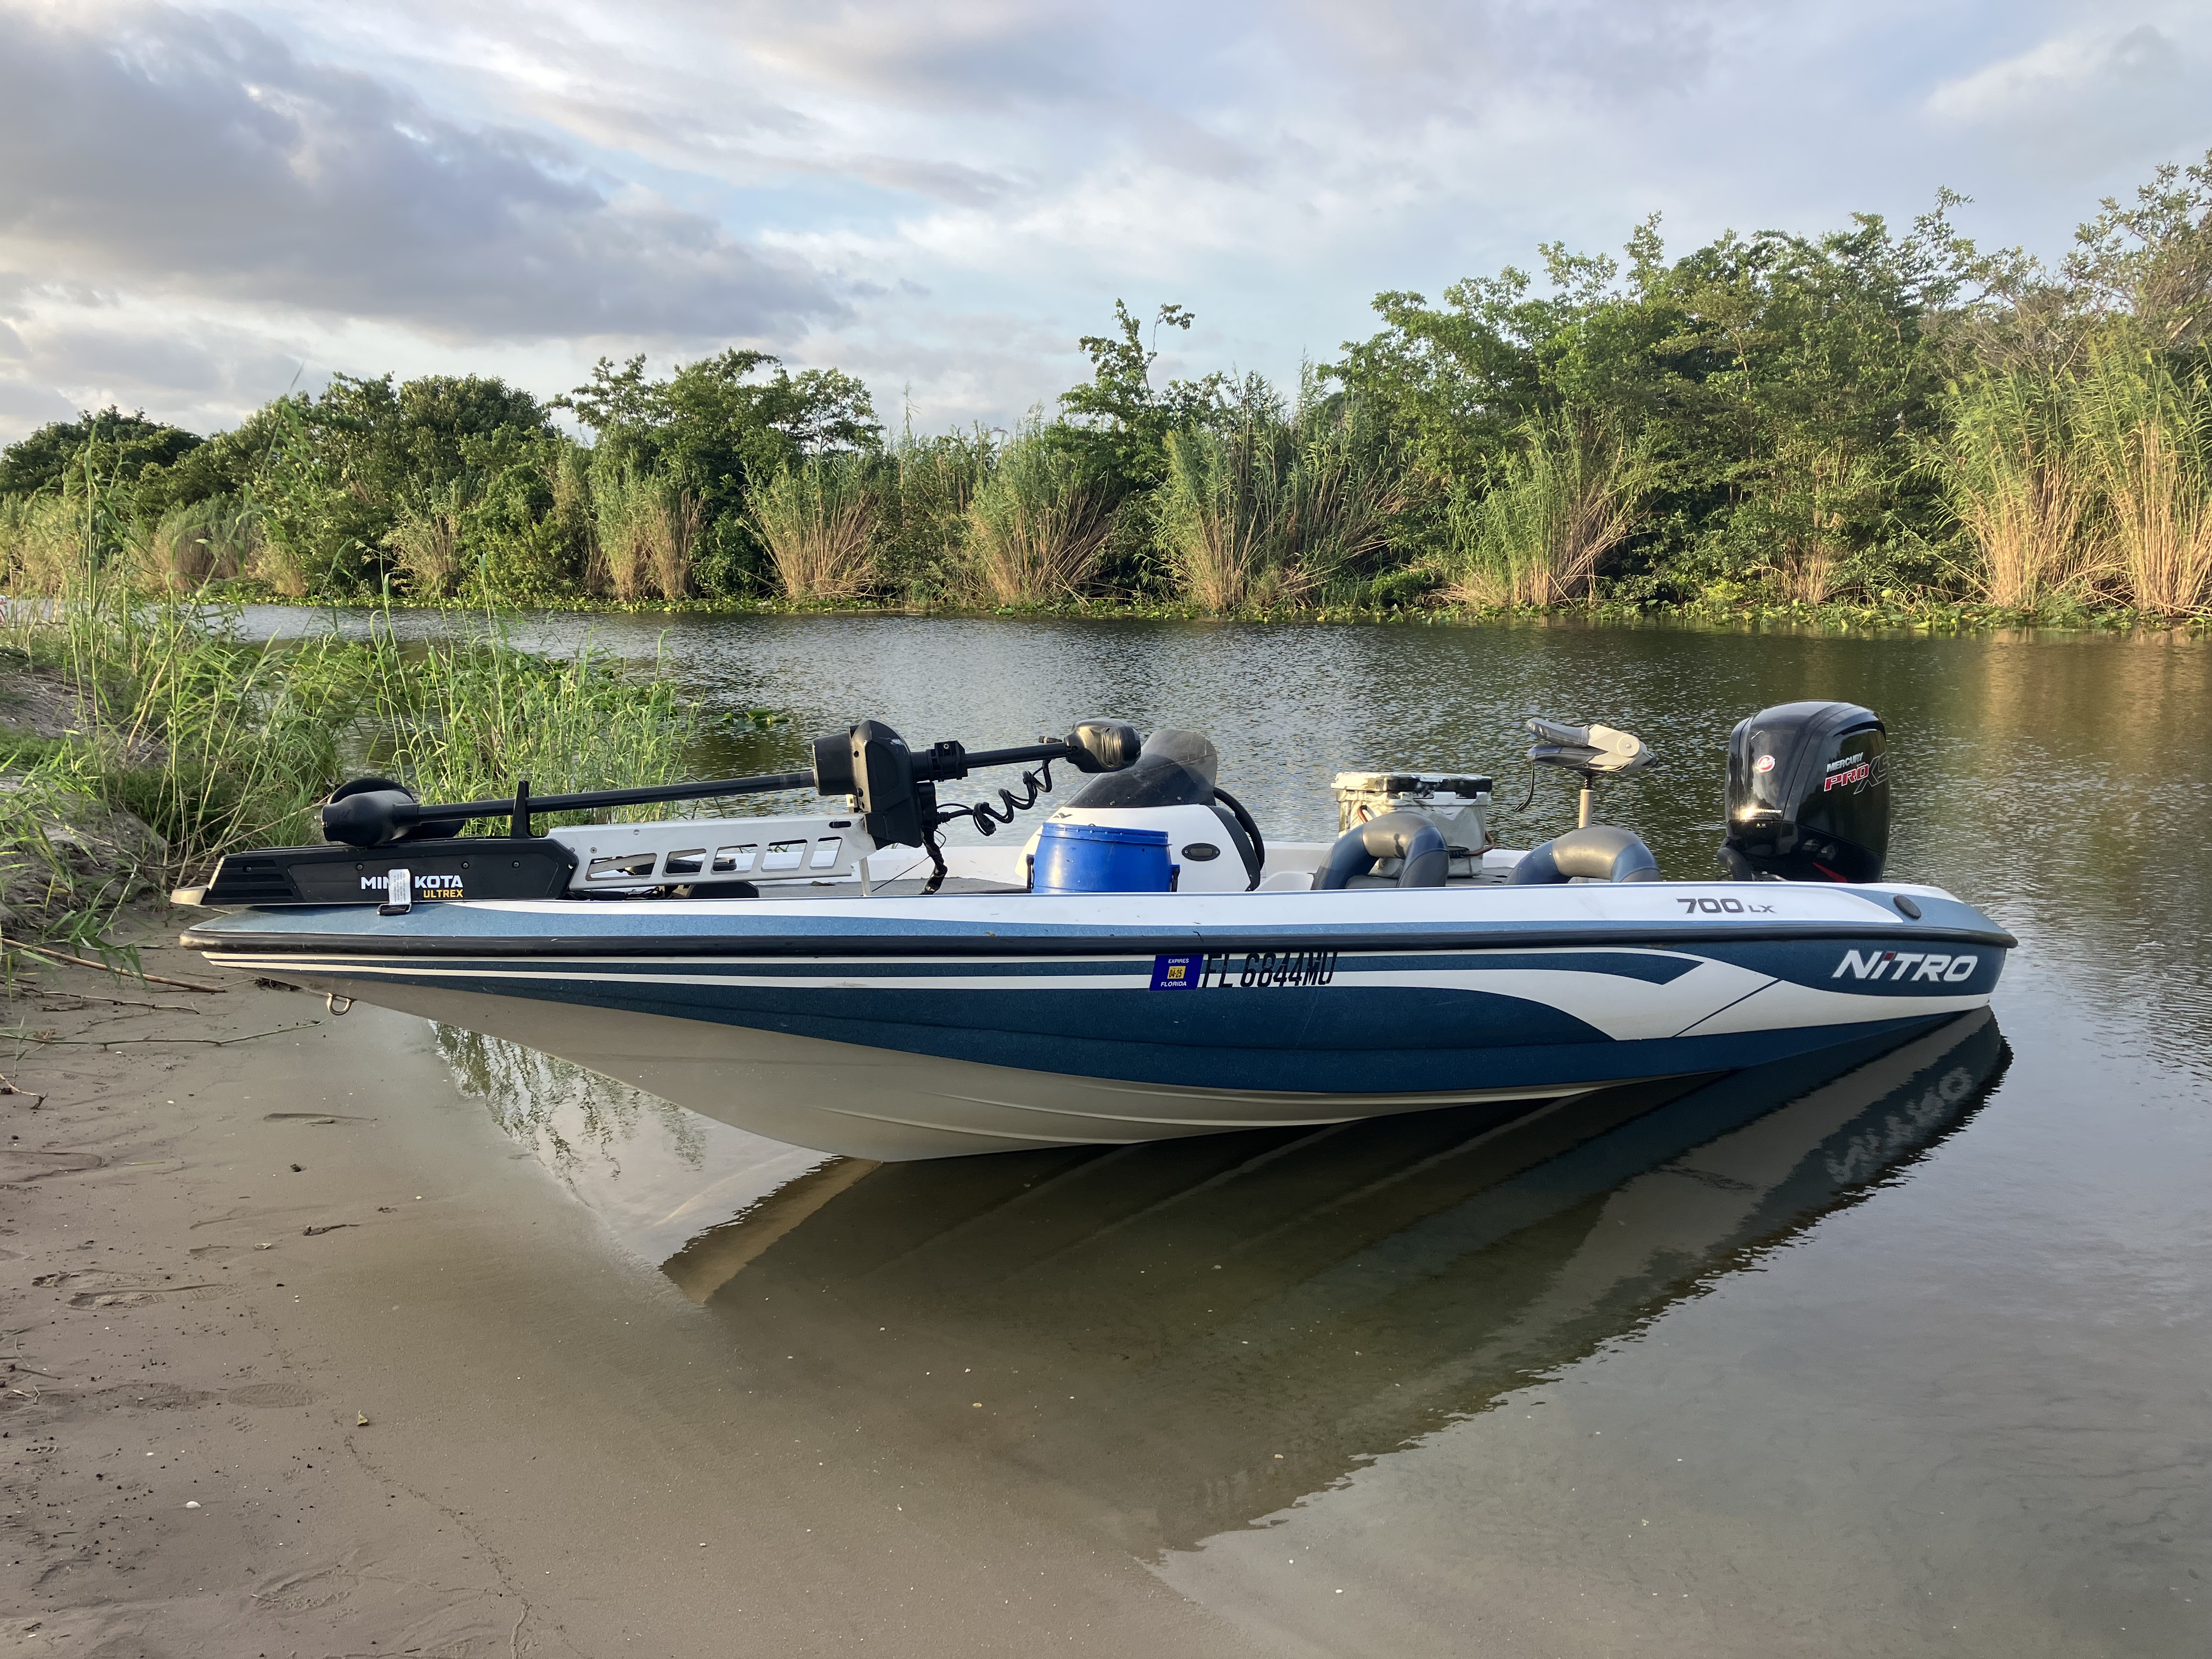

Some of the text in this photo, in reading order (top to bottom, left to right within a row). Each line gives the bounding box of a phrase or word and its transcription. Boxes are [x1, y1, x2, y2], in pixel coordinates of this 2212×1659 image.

[1826, 752, 1864, 773] MERCURY
[1824, 764, 1869, 792] PRO
[414, 874, 464, 888] KOTA
[423, 889, 464, 898] ULTREX
[1676, 898, 1778, 914] 700 LX
[1169, 969, 1183, 978] 04-25
[1201, 951, 1339, 988] FL 6844MU
